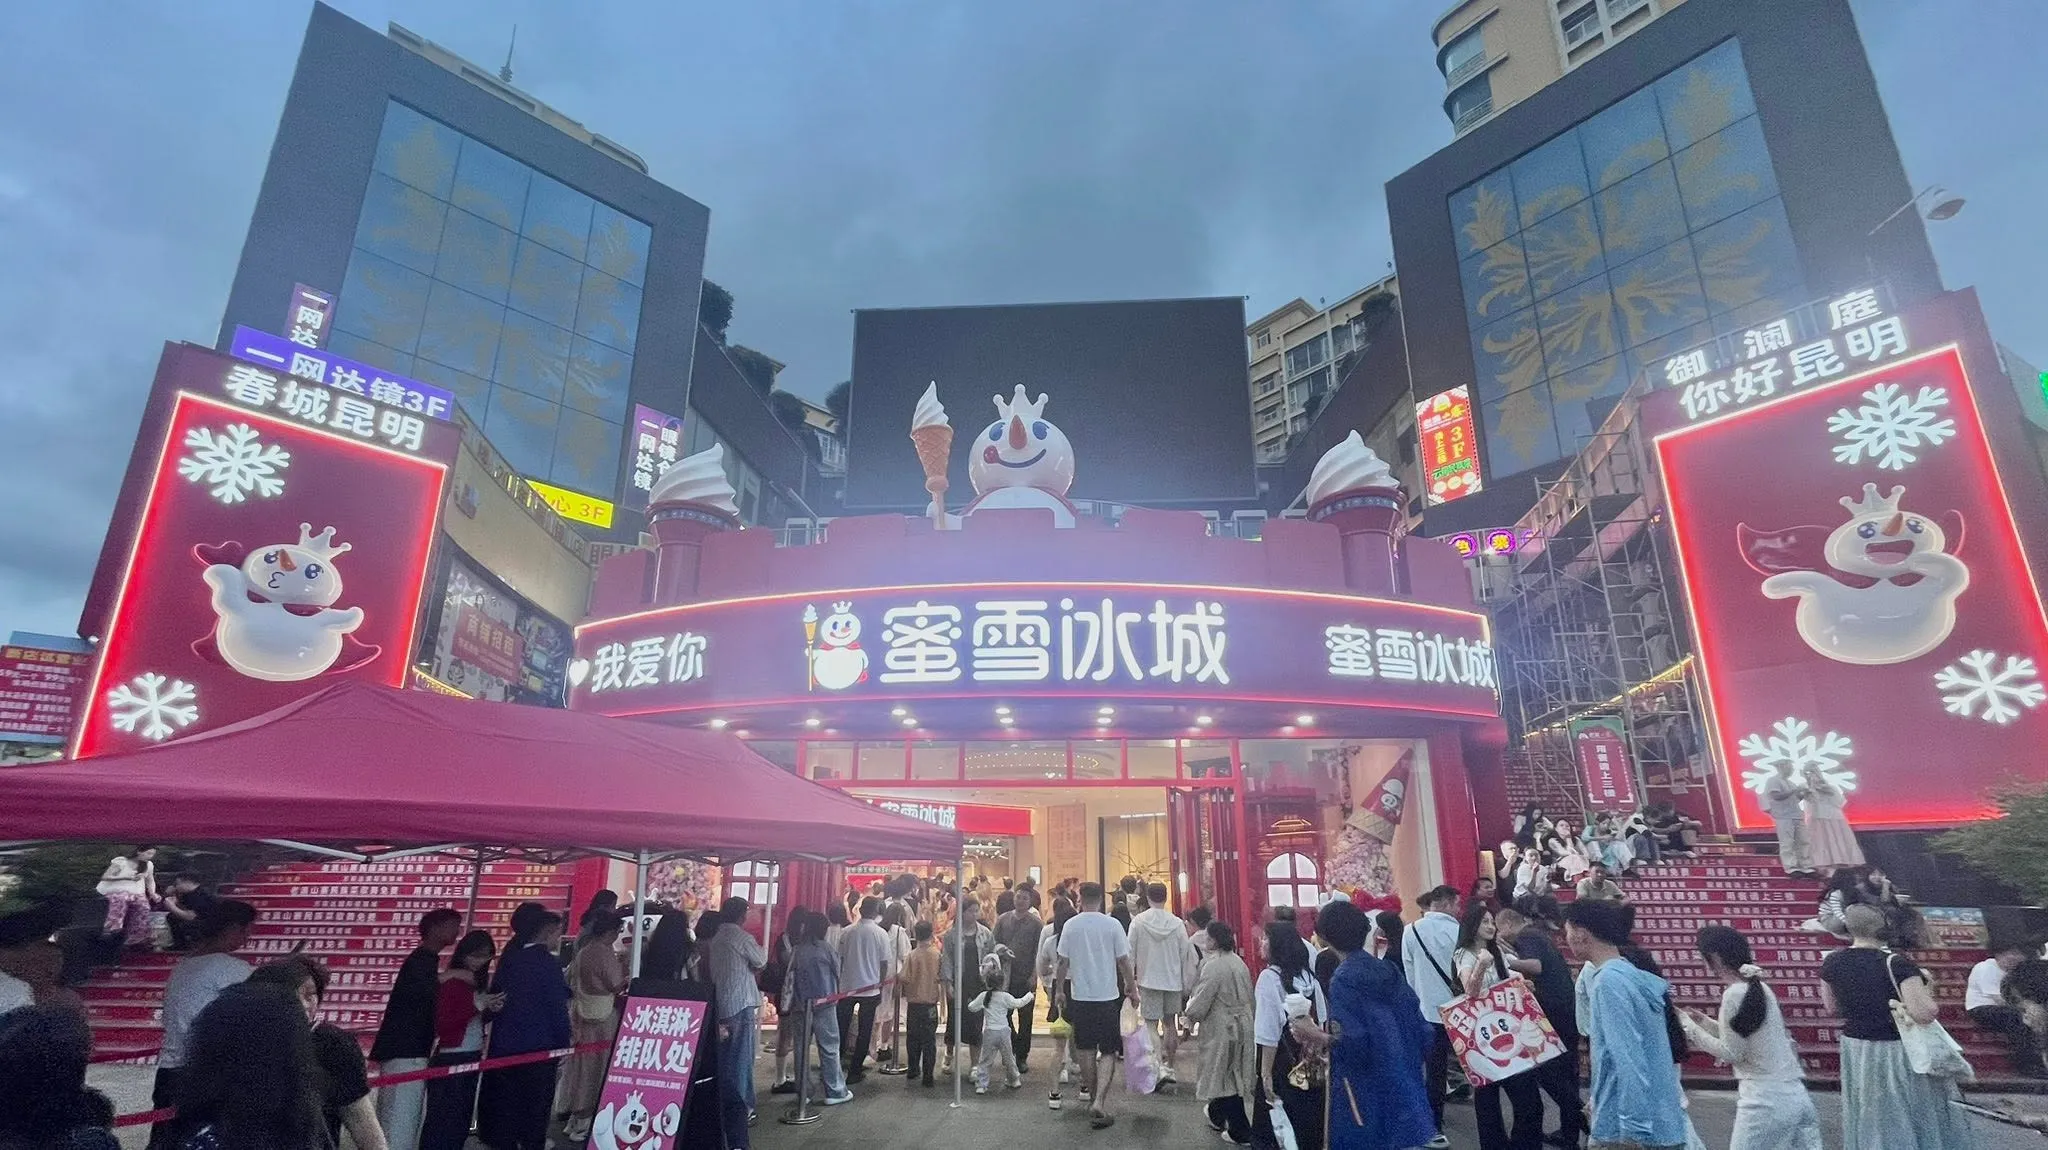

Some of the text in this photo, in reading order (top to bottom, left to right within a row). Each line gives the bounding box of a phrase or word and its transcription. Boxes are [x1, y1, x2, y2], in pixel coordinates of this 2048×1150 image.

[1664, 288, 1882, 386] 御澜庭
[1679, 316, 1908, 419] 你好昆明
[226, 364, 425, 450] 春城昆明
[578, 503, 606, 520] 3F
[591, 631, 707, 694] 我爱你
[879, 598, 1231, 686] 蜜雪冰城
[1325, 624, 1496, 688] 蜜雪冰城
[631, 1004, 692, 1037] 冰淇淋
[613, 1035, 693, 1074] 排队处
